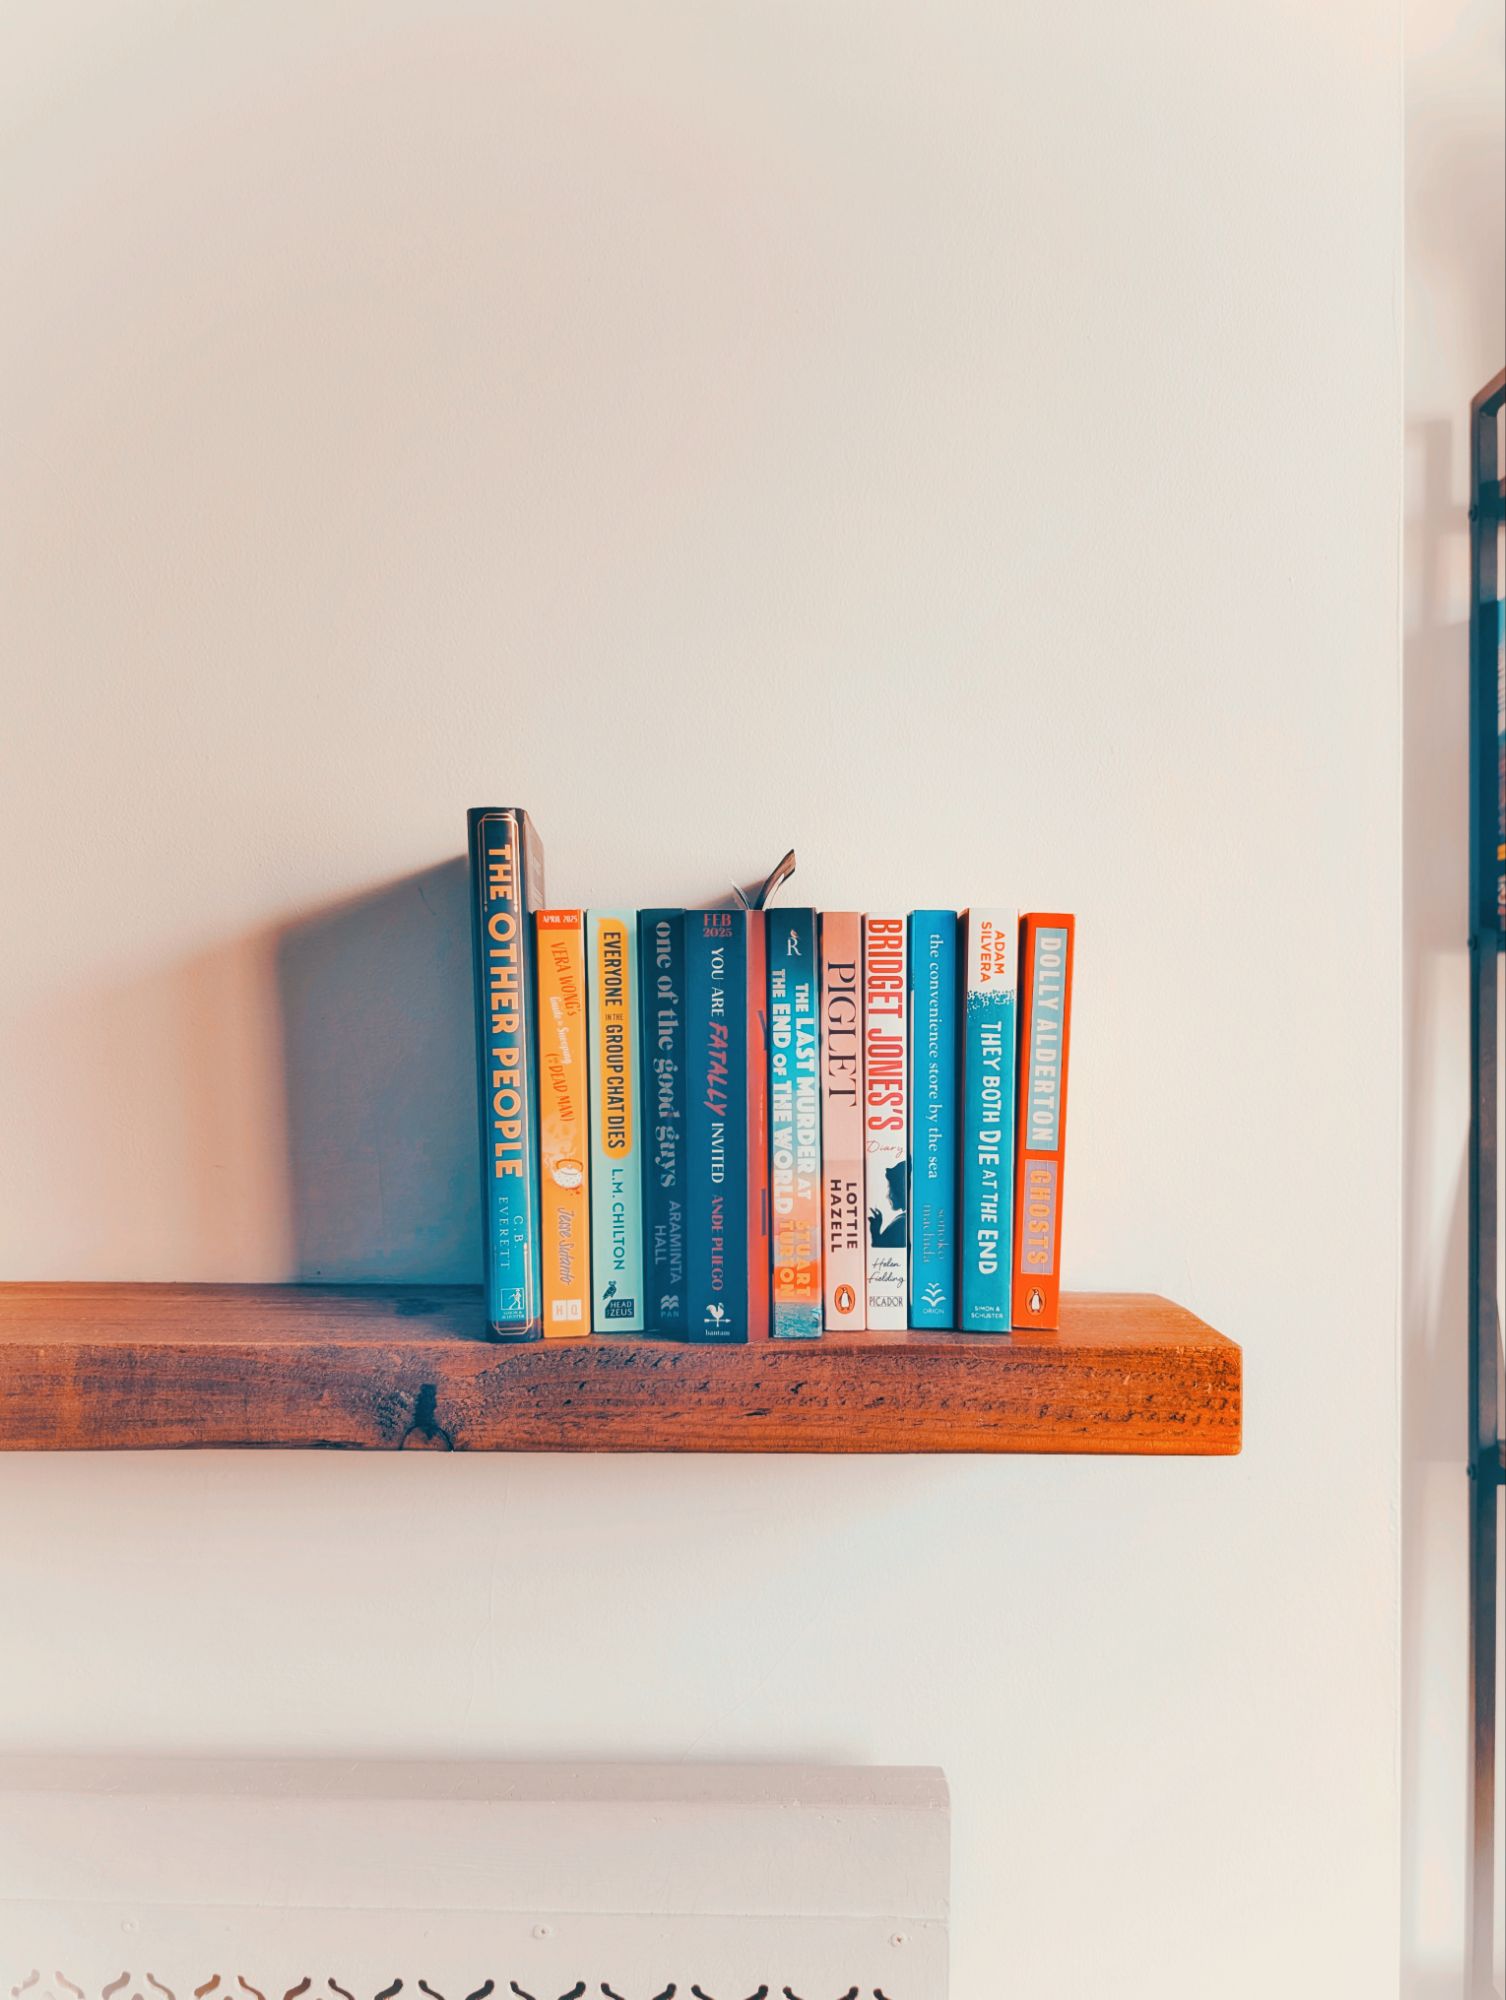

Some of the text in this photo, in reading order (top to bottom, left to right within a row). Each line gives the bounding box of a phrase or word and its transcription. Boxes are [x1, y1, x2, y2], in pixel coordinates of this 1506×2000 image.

[543, 915, 578, 924] APRIL 2025
[703, 913, 731, 926] FEB
[703, 928, 733, 938] 2025
[980, 922, 993, 983] SILVERA
[994, 931, 1005, 974] ADAM
[550, 942, 571, 973] VERA
[604, 932, 622, 1006] EVERYONE
[488, 844, 523, 1179] THE OTHER PEOPLE
[827, 960, 857, 1108] PIGLET
[867, 919, 904, 1130] BRIDGET JONES'S
[1032, 937, 1061, 1141] DOLLY ALDERTON
[548, 1065, 568, 1092] DEAD
[605, 1024, 625, 1148] GROUP CHAT DIES
[653, 921, 681, 1187] one of the good guys
[703, 947, 728, 1184] YOU ARE FATALLY INVITED
[772, 968, 793, 1214] THE END OF THE WORLD
[795, 982, 816, 1200] THE LAST MURDER AT
[924, 933, 944, 1179] the convenience store by the sea
[866, 1140, 904, 1158] Diary
[977, 1021, 1002, 1275] THEY BOTH DIE AT THE END
[498, 1196, 510, 1270] EVERETT
[557, 1207, 575, 1238] Jesse
[612, 1168, 625, 1270] L.M. CHILTON
[654, 1225, 667, 1264] HALL
[668, 1200, 682, 1285] ARAMINTA
[711, 1194, 724, 1291] ANDE PLIEGO
[830, 1179, 842, 1253] HAZELL
[846, 1182, 858, 1249] LOTTIE
[1026, 1170, 1052, 1264] GHOSTS
[779, 1220, 795, 1297] TURTON
[796, 1220, 811, 1297] STUART
[868, 1271, 904, 1288] Fielding
[872, 1257, 900, 1270] Helen
[869, 1296, 903, 1307] PICADOR
